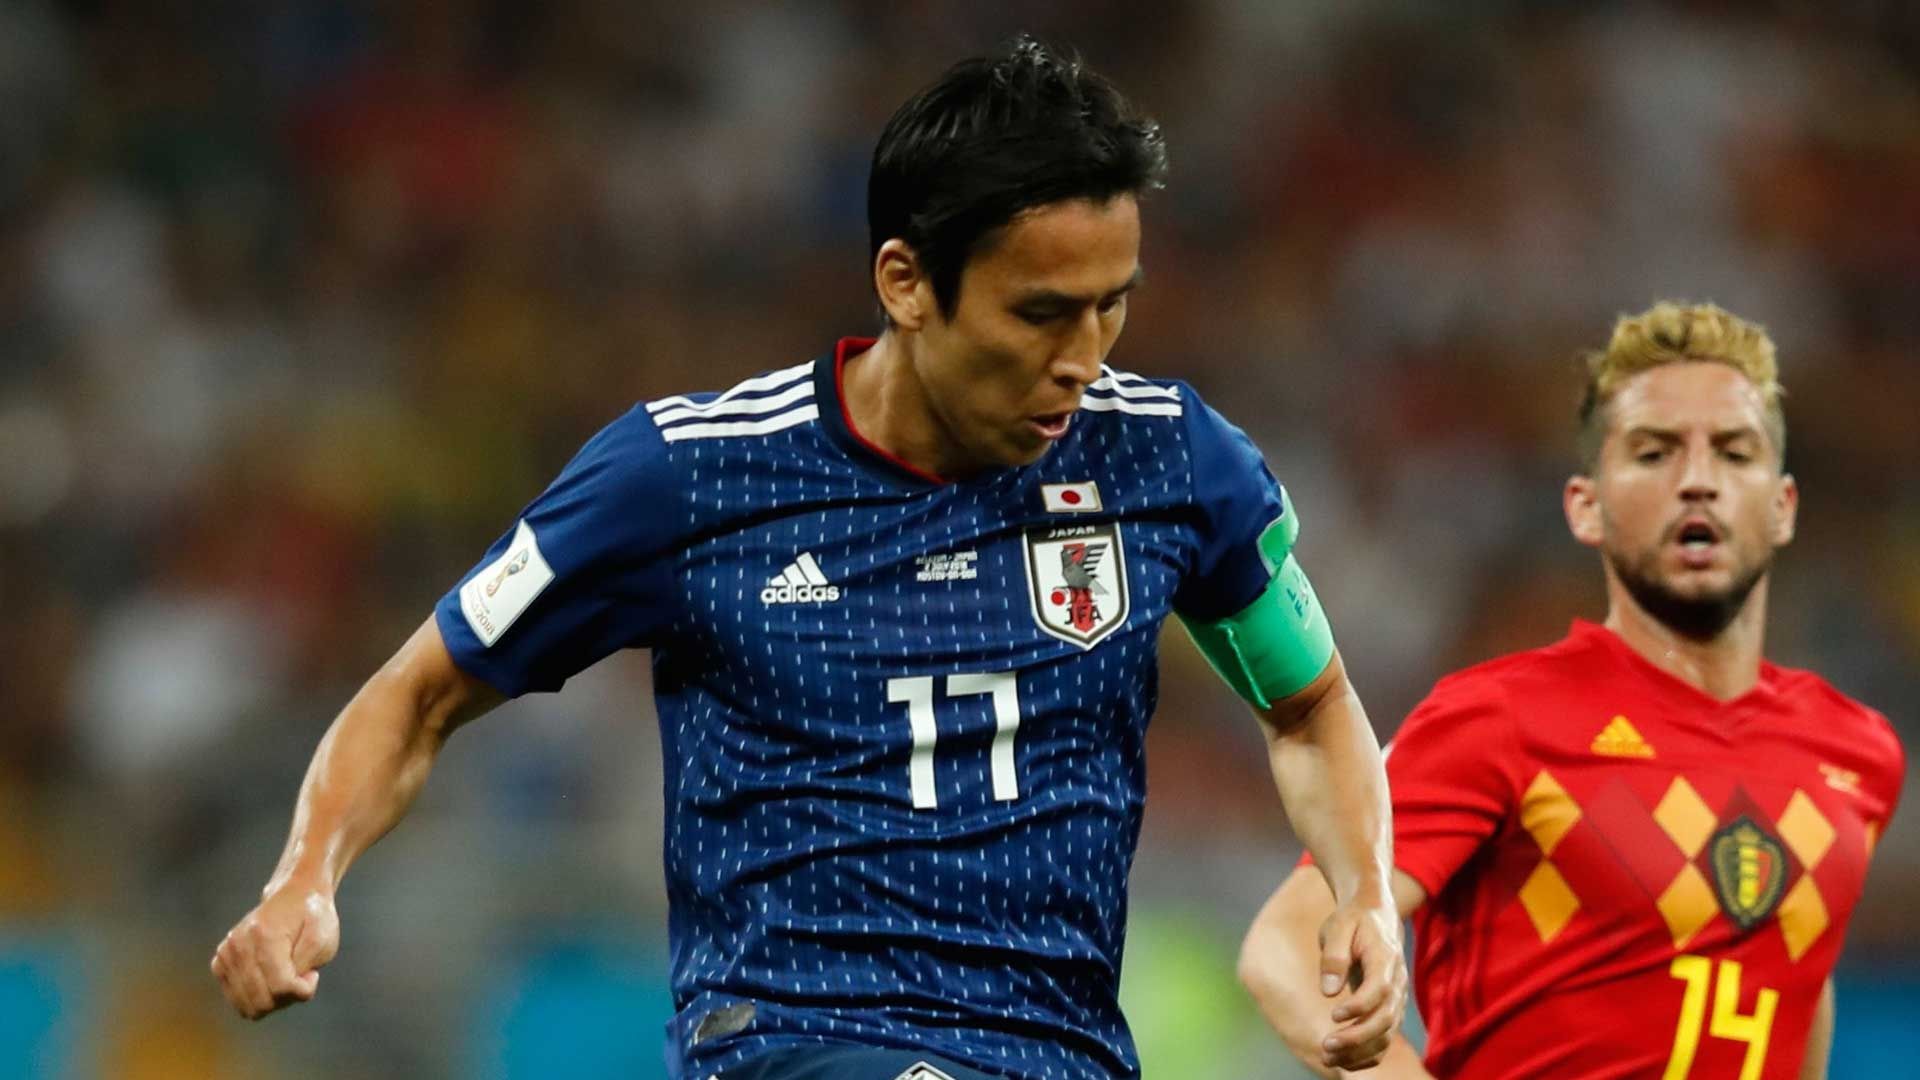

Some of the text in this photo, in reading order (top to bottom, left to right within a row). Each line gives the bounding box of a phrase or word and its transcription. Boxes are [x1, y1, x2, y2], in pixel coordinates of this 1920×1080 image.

[1048, 525, 1096, 539] JAPAN
[760, 583, 840, 604] adidas
[887, 671, 1021, 810] 17
[1662, 955, 1780, 1080] 14
